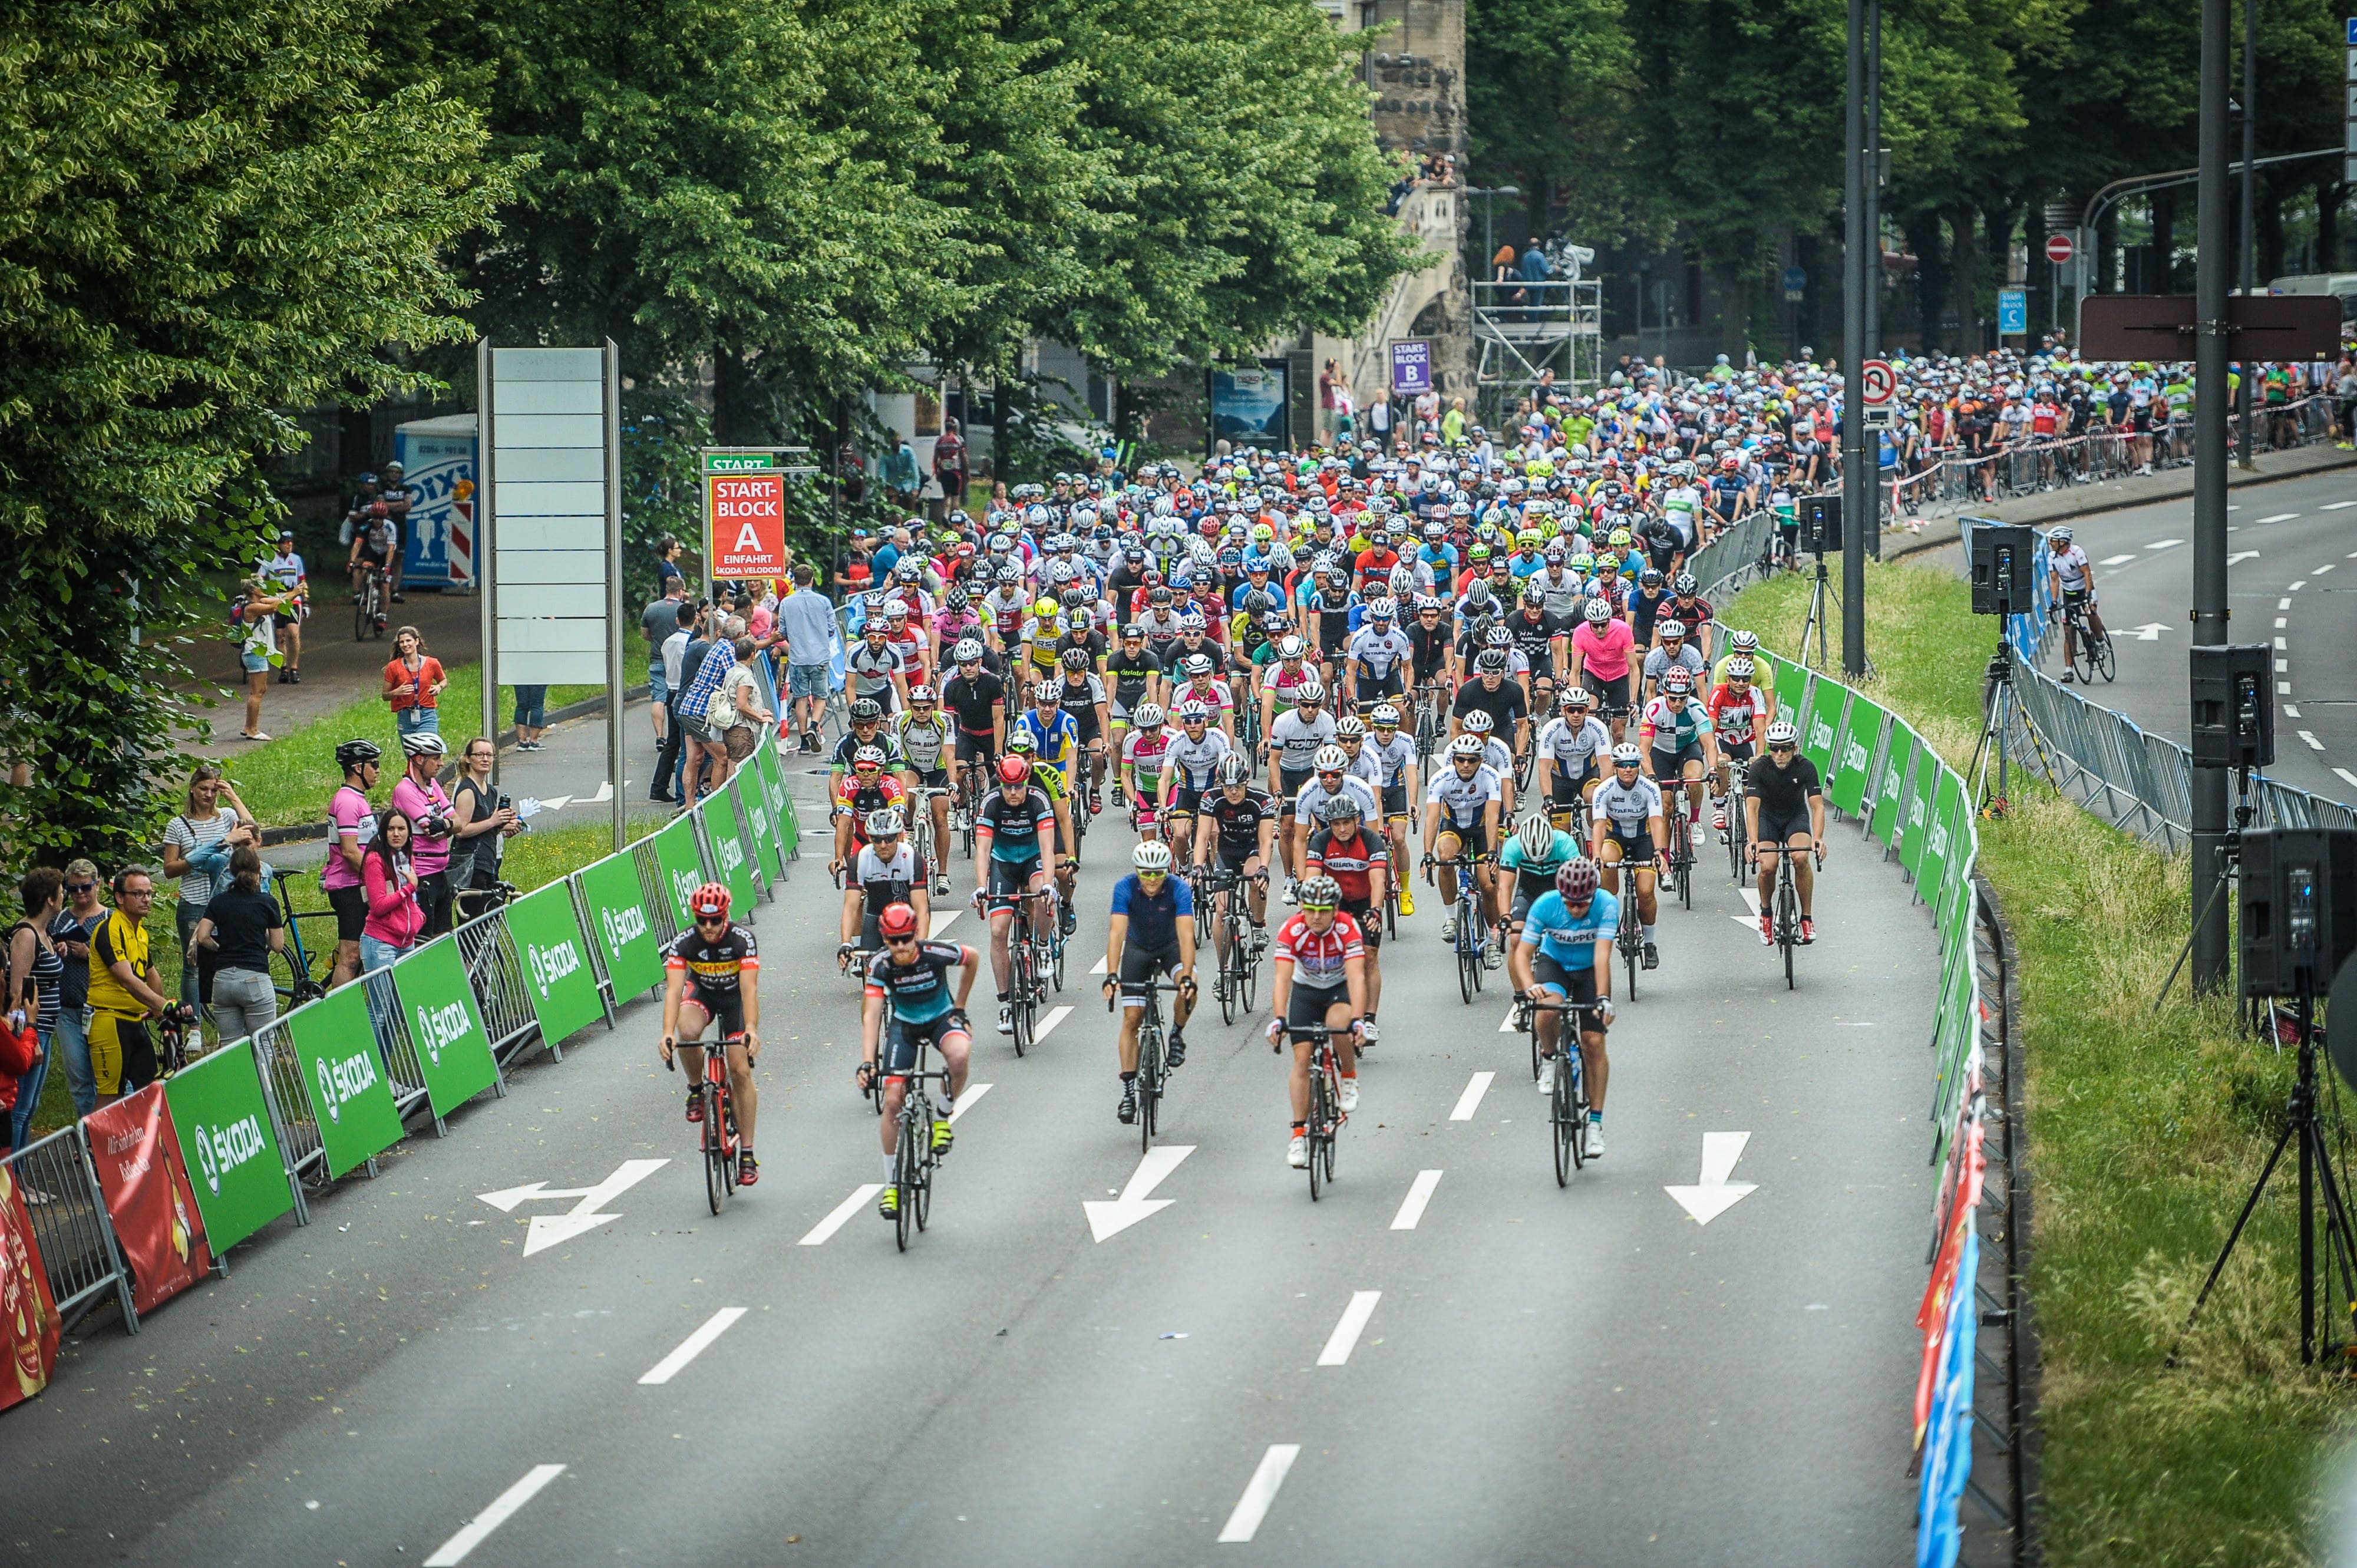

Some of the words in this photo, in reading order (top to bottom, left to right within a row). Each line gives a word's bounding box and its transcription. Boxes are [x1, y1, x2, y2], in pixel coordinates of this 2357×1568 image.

[1394, 344, 1426, 354] START-
[1395, 354, 1426, 364] BLOCK
[1405, 365, 1418, 381] B
[717, 481, 777, 498] START-
[718, 501, 778, 517] BLOCK
[733, 523, 762, 552] A
[715, 566, 742, 575] ŠKODA
[724, 554, 773, 565] EINFAHRT
[1544, 722, 1562, 750] STABILUS
[1587, 721, 1606, 747] STABILUS
[1490, 741, 1508, 768] STABILUS
[1847, 736, 1868, 775] ŠKODA
[1595, 782, 1614, 810] STABILUS
[1238, 814, 1253, 822] ISB
[723, 836, 744, 872] ŠKODA
[612, 904, 648, 946] ŠKODA
[540, 939, 581, 984] ŠKODA
[429, 999, 473, 1049] ŠKODA
[331, 1050, 378, 1103] ŠKODA
[212, 1114, 266, 1174] ŠKODA
